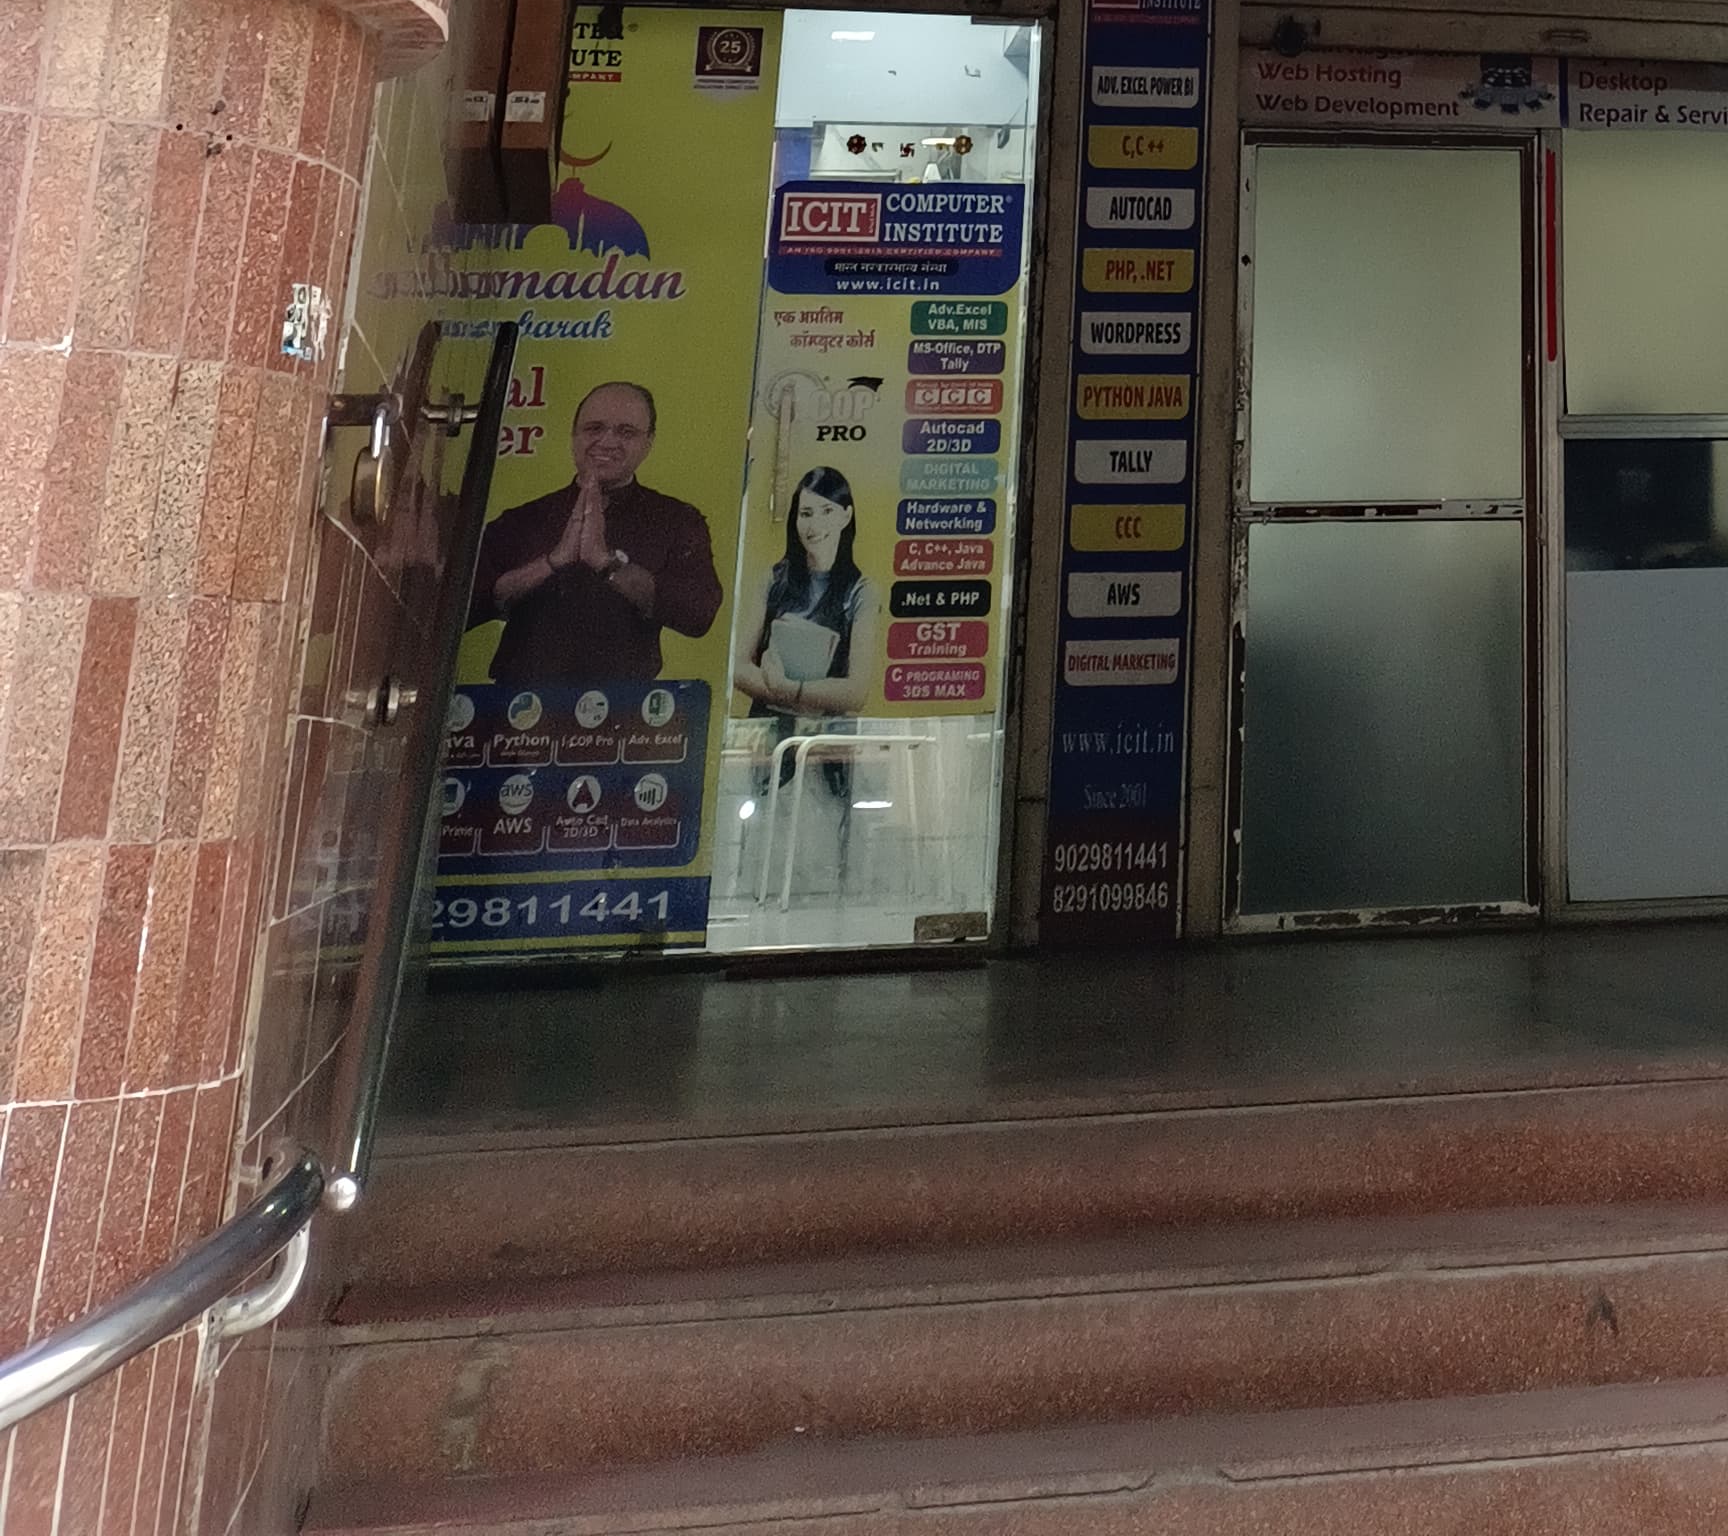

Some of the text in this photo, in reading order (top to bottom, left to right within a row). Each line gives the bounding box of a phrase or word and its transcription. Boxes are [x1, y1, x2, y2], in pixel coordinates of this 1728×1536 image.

[719, 40, 742, 54] 25
[1257, 62, 1402, 89] Web Hosting
[1577, 71, 1668, 96] Desktop
[1120, 76, 1149, 96] EXCEL
[1149, 76, 1184, 97] POWER
[1255, 93, 1459, 120] Web Development
[1579, 103, 1648, 127] Repair
[1655, 104, 1670, 123] &
[786, 201, 867, 234] ICIT
[1109, 196, 1172, 222] AUTOCAD
[883, 223, 1004, 244] INSTITUTE
[836, 278, 940, 291] www.icit.in
[1090, 321, 1182, 345] WORDPRESS
[977, 342, 1001, 354] DTP
[940, 357, 969, 372] Tally
[1082, 385, 1183, 408] PYTHON JAVA
[816, 425, 867, 442] PRO
[920, 421, 985, 434] Autocad
[1109, 450, 1153, 473] TALLY
[906, 501, 972, 515] Hardware
[905, 517, 983, 532] Networking
[1115, 516, 1142, 539] CCC
[950, 591, 980, 605] PHP
[1106, 582, 1141, 606] AWS
[916, 622, 961, 642] GST
[907, 643, 968, 657] Training
[1067, 653, 1176, 672] DIGITAL MARKETING
[492, 817, 532, 836] AWS
[1054, 839, 1169, 873] 9029811441
[1052, 880, 1169, 914] 8291099846
[431, 890, 670, 928] 29811441
